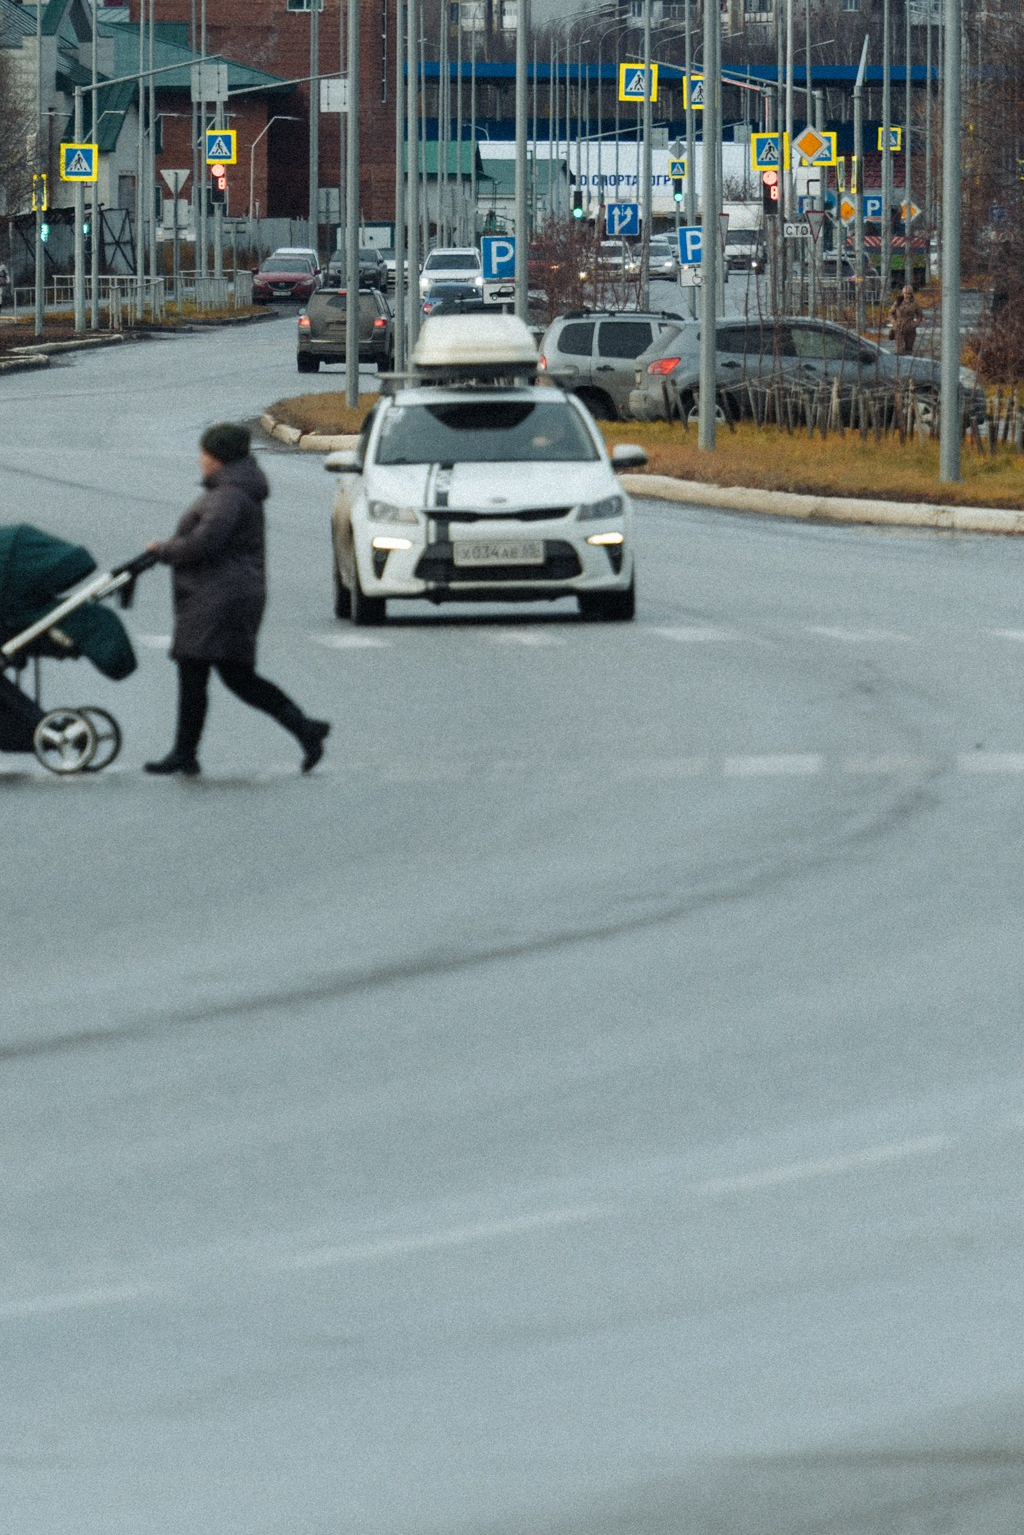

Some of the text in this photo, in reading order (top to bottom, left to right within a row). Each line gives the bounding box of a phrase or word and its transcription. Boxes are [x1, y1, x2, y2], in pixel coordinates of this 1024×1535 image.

[867, 200, 880, 216] P
[786, 225, 816, 236] СТО
[686, 230, 702, 261] P
[491, 241, 514, 274] P
